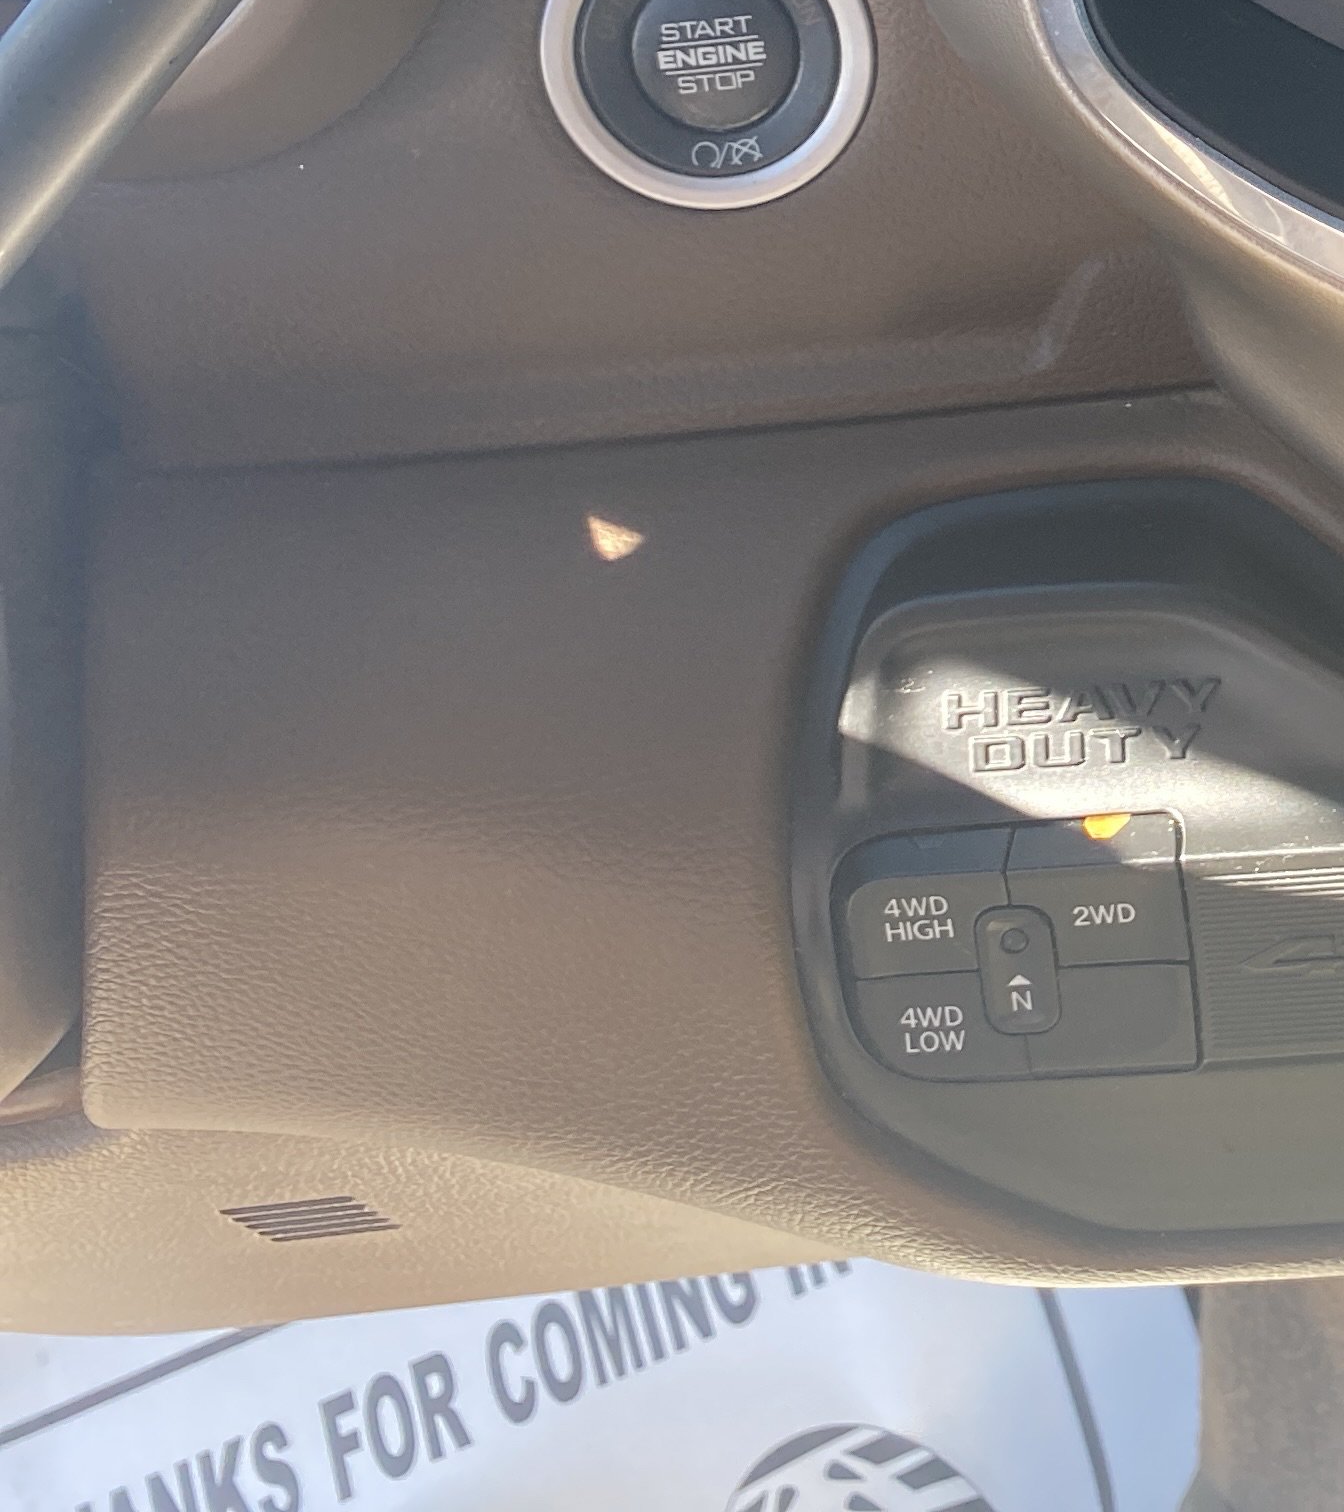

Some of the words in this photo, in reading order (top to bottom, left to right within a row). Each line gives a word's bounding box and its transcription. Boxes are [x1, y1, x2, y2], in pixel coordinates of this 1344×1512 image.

[660, 15, 753, 41] START
[656, 40, 767, 70] ENGINE
[677, 69, 756, 95] STOP
[941, 676, 1222, 731] HEAVY
[967, 722, 1202, 773] DUTY
[883, 895, 949, 919] 4WD
[1072, 903, 1136, 927] 2WD
[884, 918, 955, 942] HIGH
[1011, 989, 1033, 1012] N
[900, 1005, 964, 1029] 4WD
[904, 1028, 966, 1053] LOW
[75, 1421, 302, 1512] NKS
[318, 1350, 473, 1505] FOR
[485, 1270, 760, 1425] COMING
